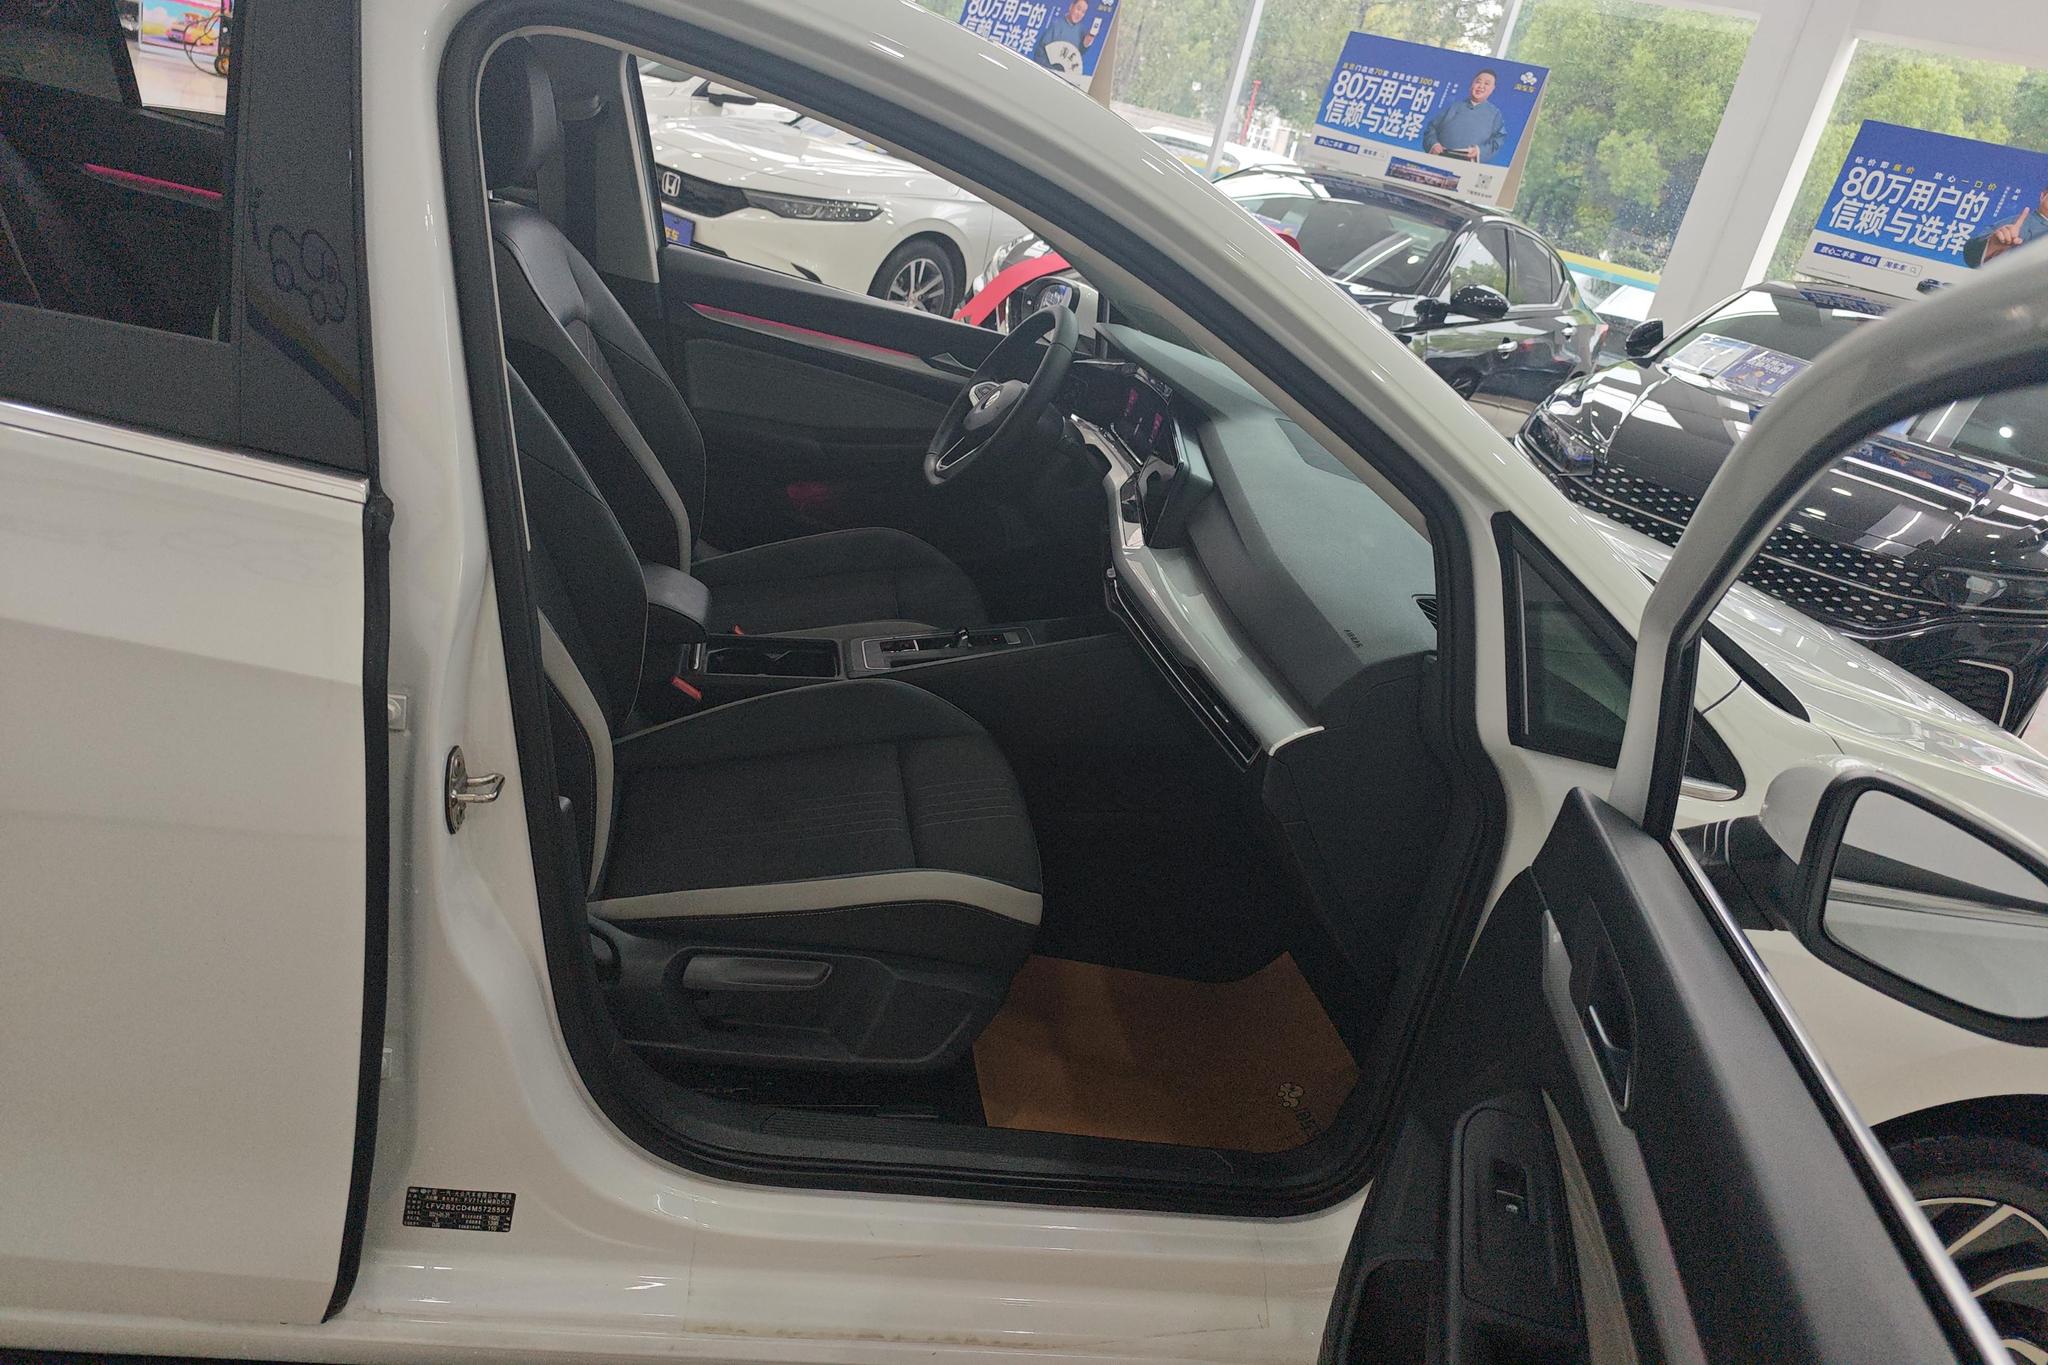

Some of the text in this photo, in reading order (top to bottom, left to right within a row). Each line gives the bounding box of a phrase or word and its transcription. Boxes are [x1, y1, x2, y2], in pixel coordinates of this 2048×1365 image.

[967, 0, 1047, 28] 80万用户的
[1333, 70, 1435, 113] 80万用户的
[1324, 96, 1425, 141] 信赖与选择
[1841, 167, 1990, 222] 80万用户的
[1933, 171, 1997, 191] 放心一口价
[1828, 196, 1976, 256] 信赖与选择
